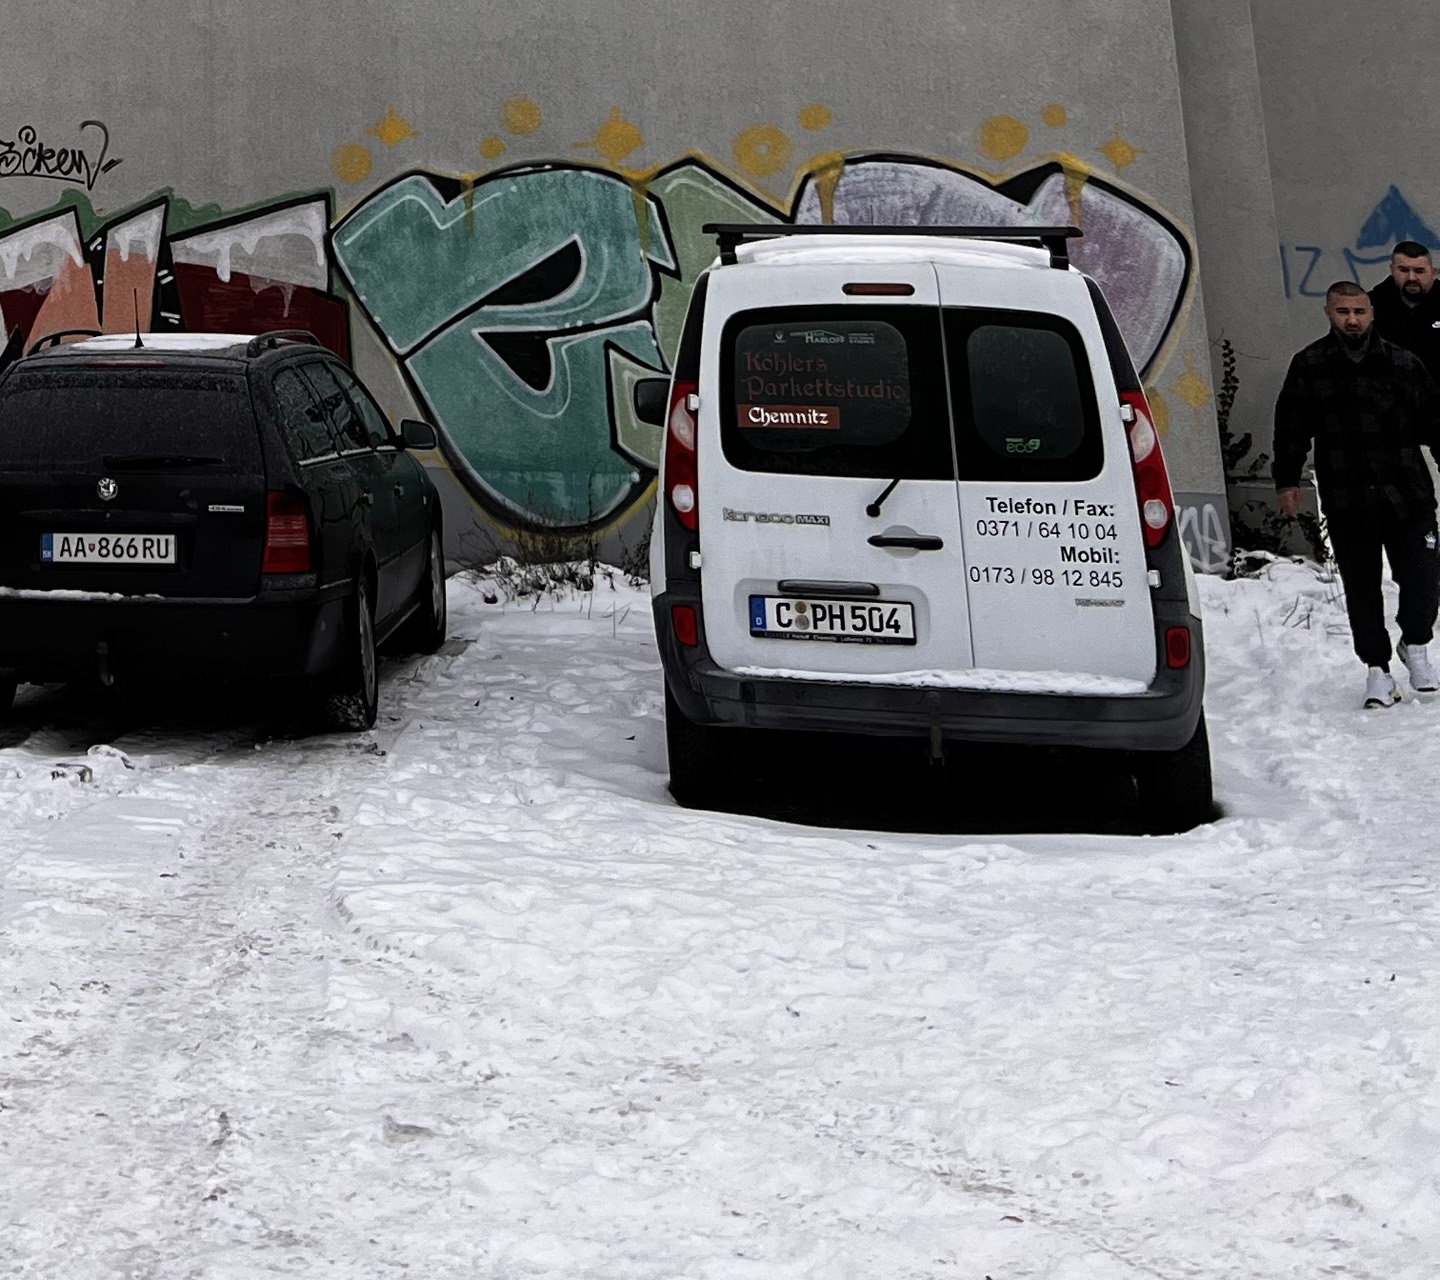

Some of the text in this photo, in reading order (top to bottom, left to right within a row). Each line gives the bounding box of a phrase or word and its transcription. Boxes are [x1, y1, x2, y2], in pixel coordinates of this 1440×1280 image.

[745, 352, 828, 375] Köhlers
[748, 407, 829, 427] Chemnitz
[986, 497, 1115, 517] Telefon / Fax:
[796, 516, 828, 525] MAXI
[977, 520, 1117, 540] 0371 / 64 10 04
[60, 536, 87, 558] AA
[1060, 546, 1120, 564] Mobil:
[969, 567, 1123, 588] 0173 / 98 12 845
[776, 602, 793, 628] C
